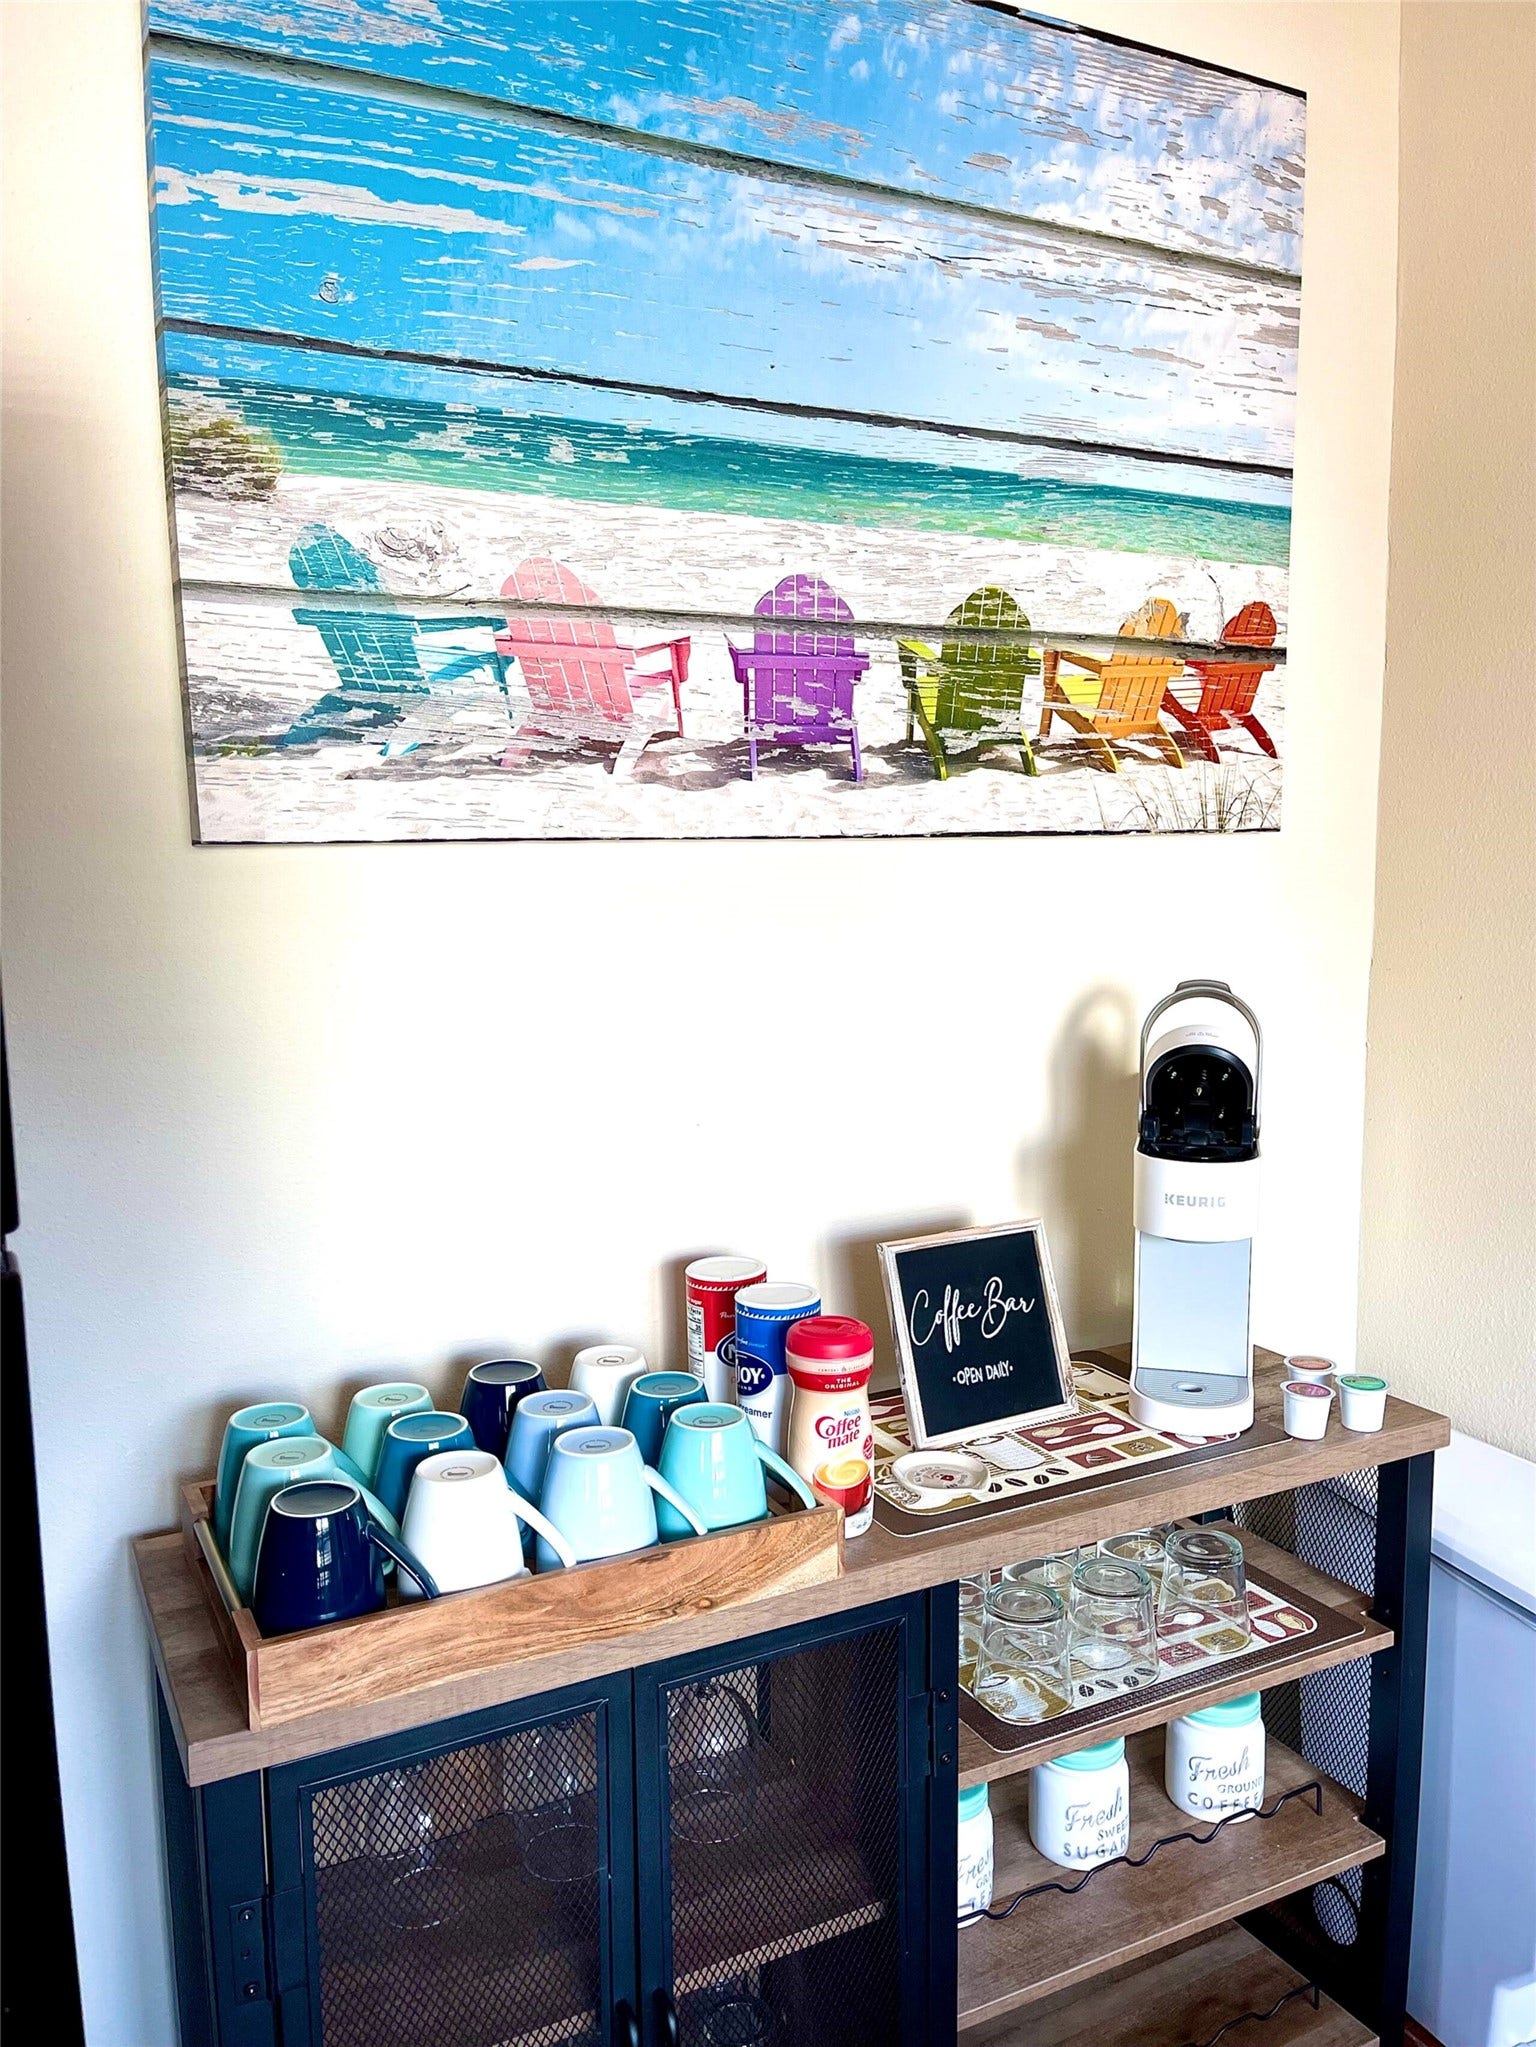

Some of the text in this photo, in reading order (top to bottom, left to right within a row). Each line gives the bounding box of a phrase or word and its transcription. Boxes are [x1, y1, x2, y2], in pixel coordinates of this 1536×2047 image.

[1164, 1193, 1226, 1208] KEURIG
[910, 1276, 1035, 1353] Coffee Bar
[956, 1360, 1010, 1385] OPEN DAILY
[824, 1381, 860, 1390] ORIGINAL
[815, 1415, 862, 1439] Coffee
[827, 1429, 860, 1449] mate
[1188, 1745, 1249, 1782] Fresh
[1065, 1787, 1123, 1831] Fresh
[1063, 1834, 1127, 1860] SUGAR
